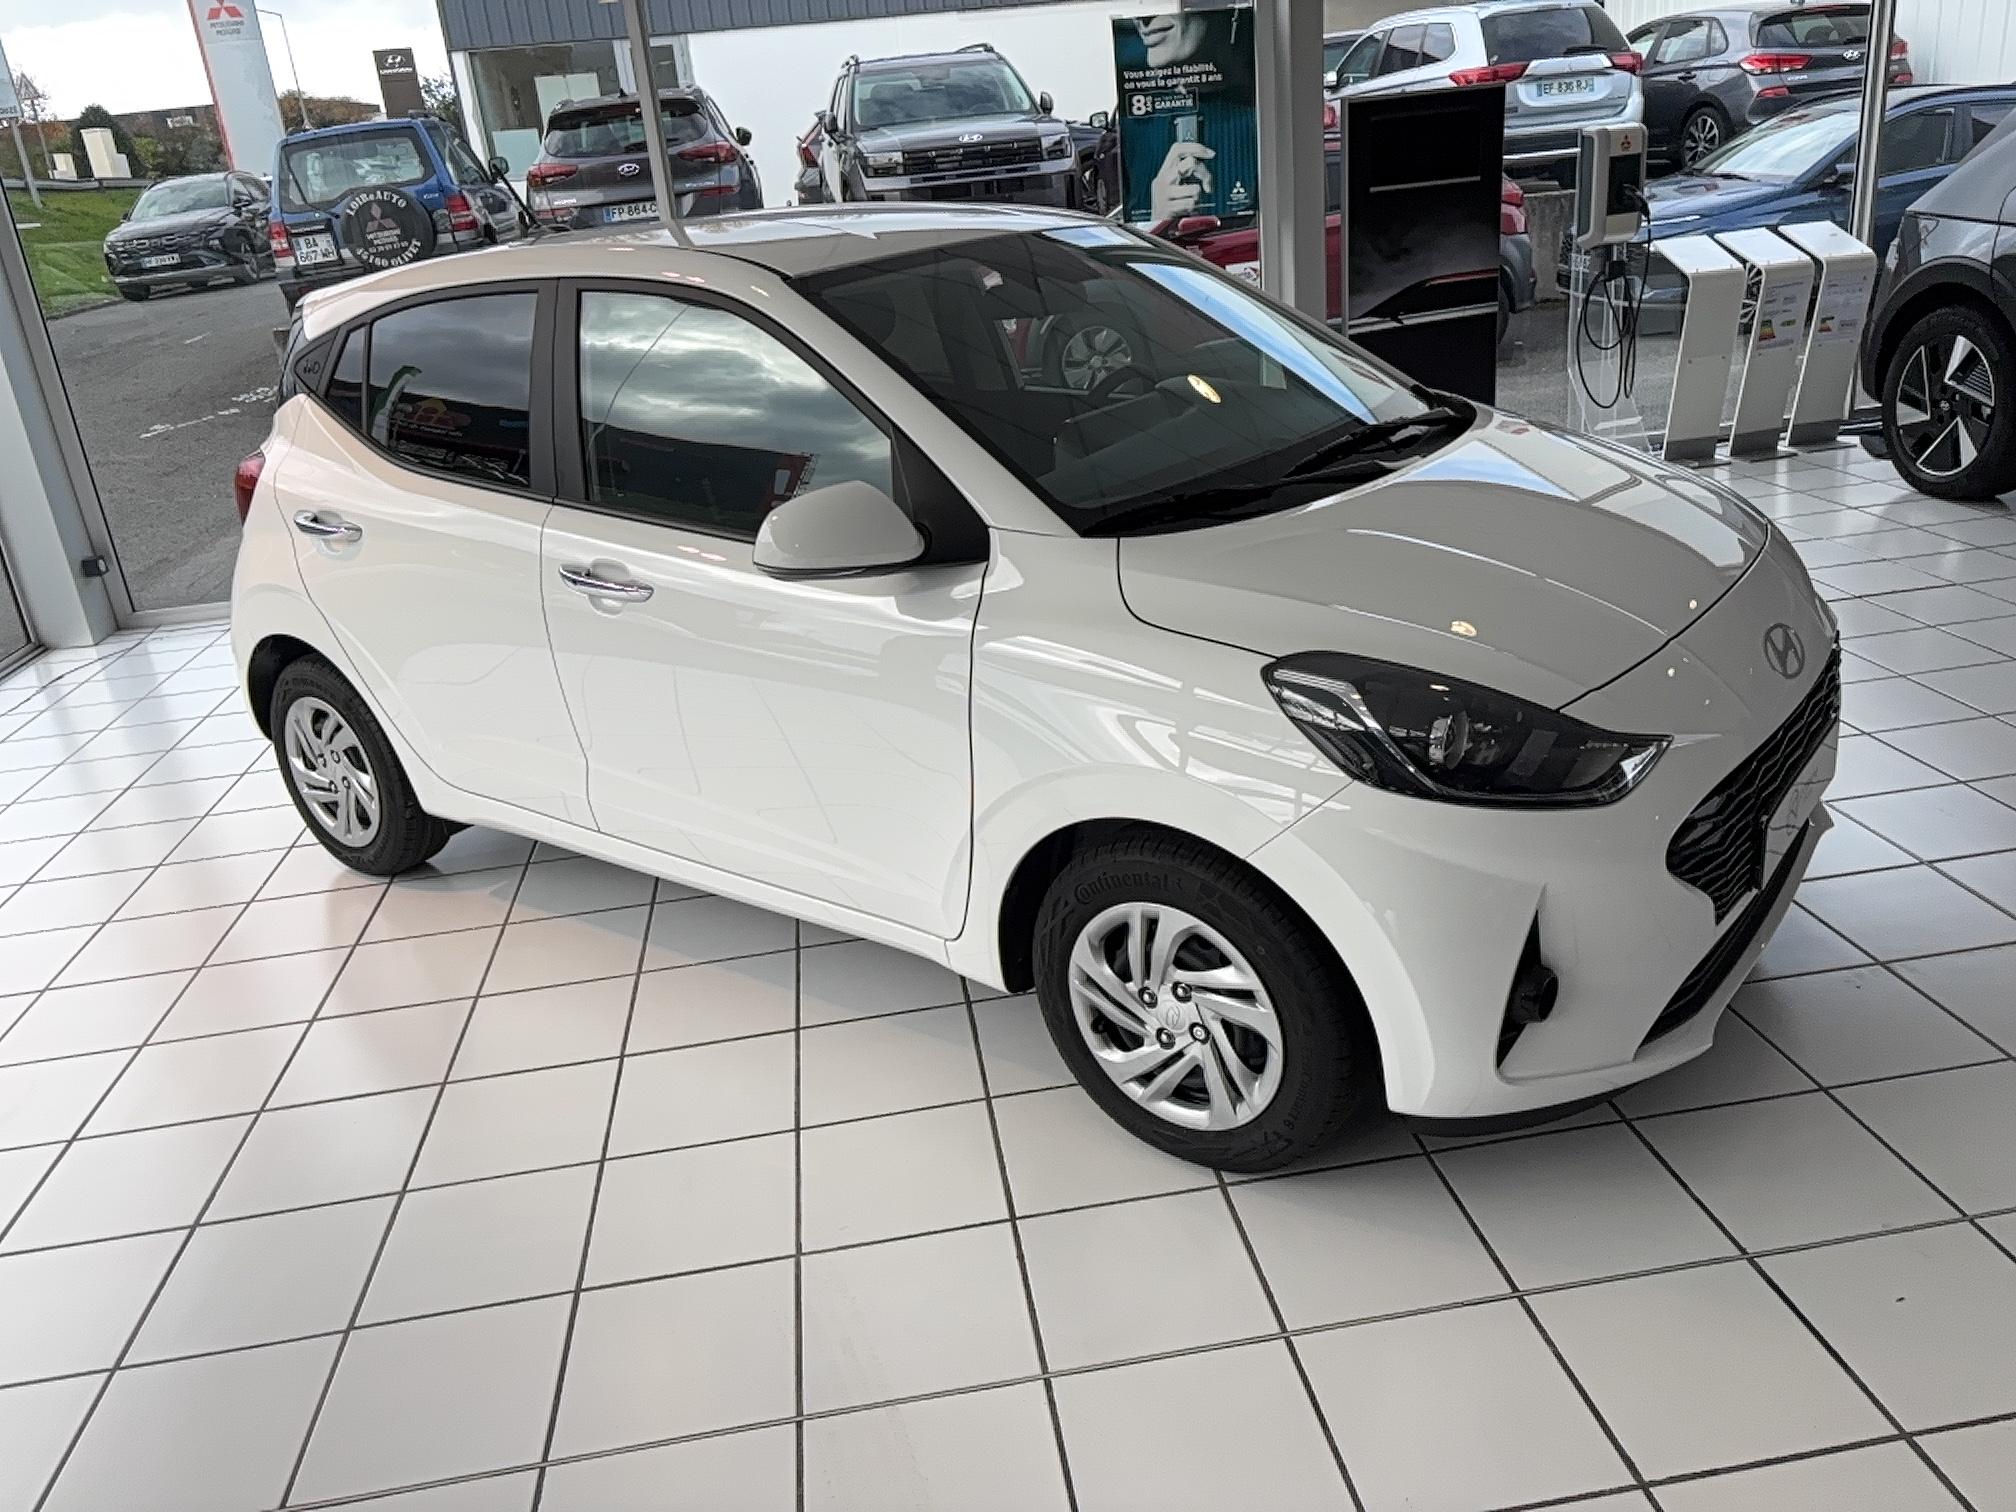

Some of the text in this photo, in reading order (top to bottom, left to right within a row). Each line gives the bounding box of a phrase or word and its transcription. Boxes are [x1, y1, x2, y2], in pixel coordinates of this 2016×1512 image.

[1123, 70, 1144, 79] Vous
[1145, 67, 1172, 78] exigez
[1136, 80, 1156, 89] vous
[1132, 94, 1146, 116] 8
[1154, 98, 1194, 110] GARANTIE
[1074, 871, 1169, 905] Continental
